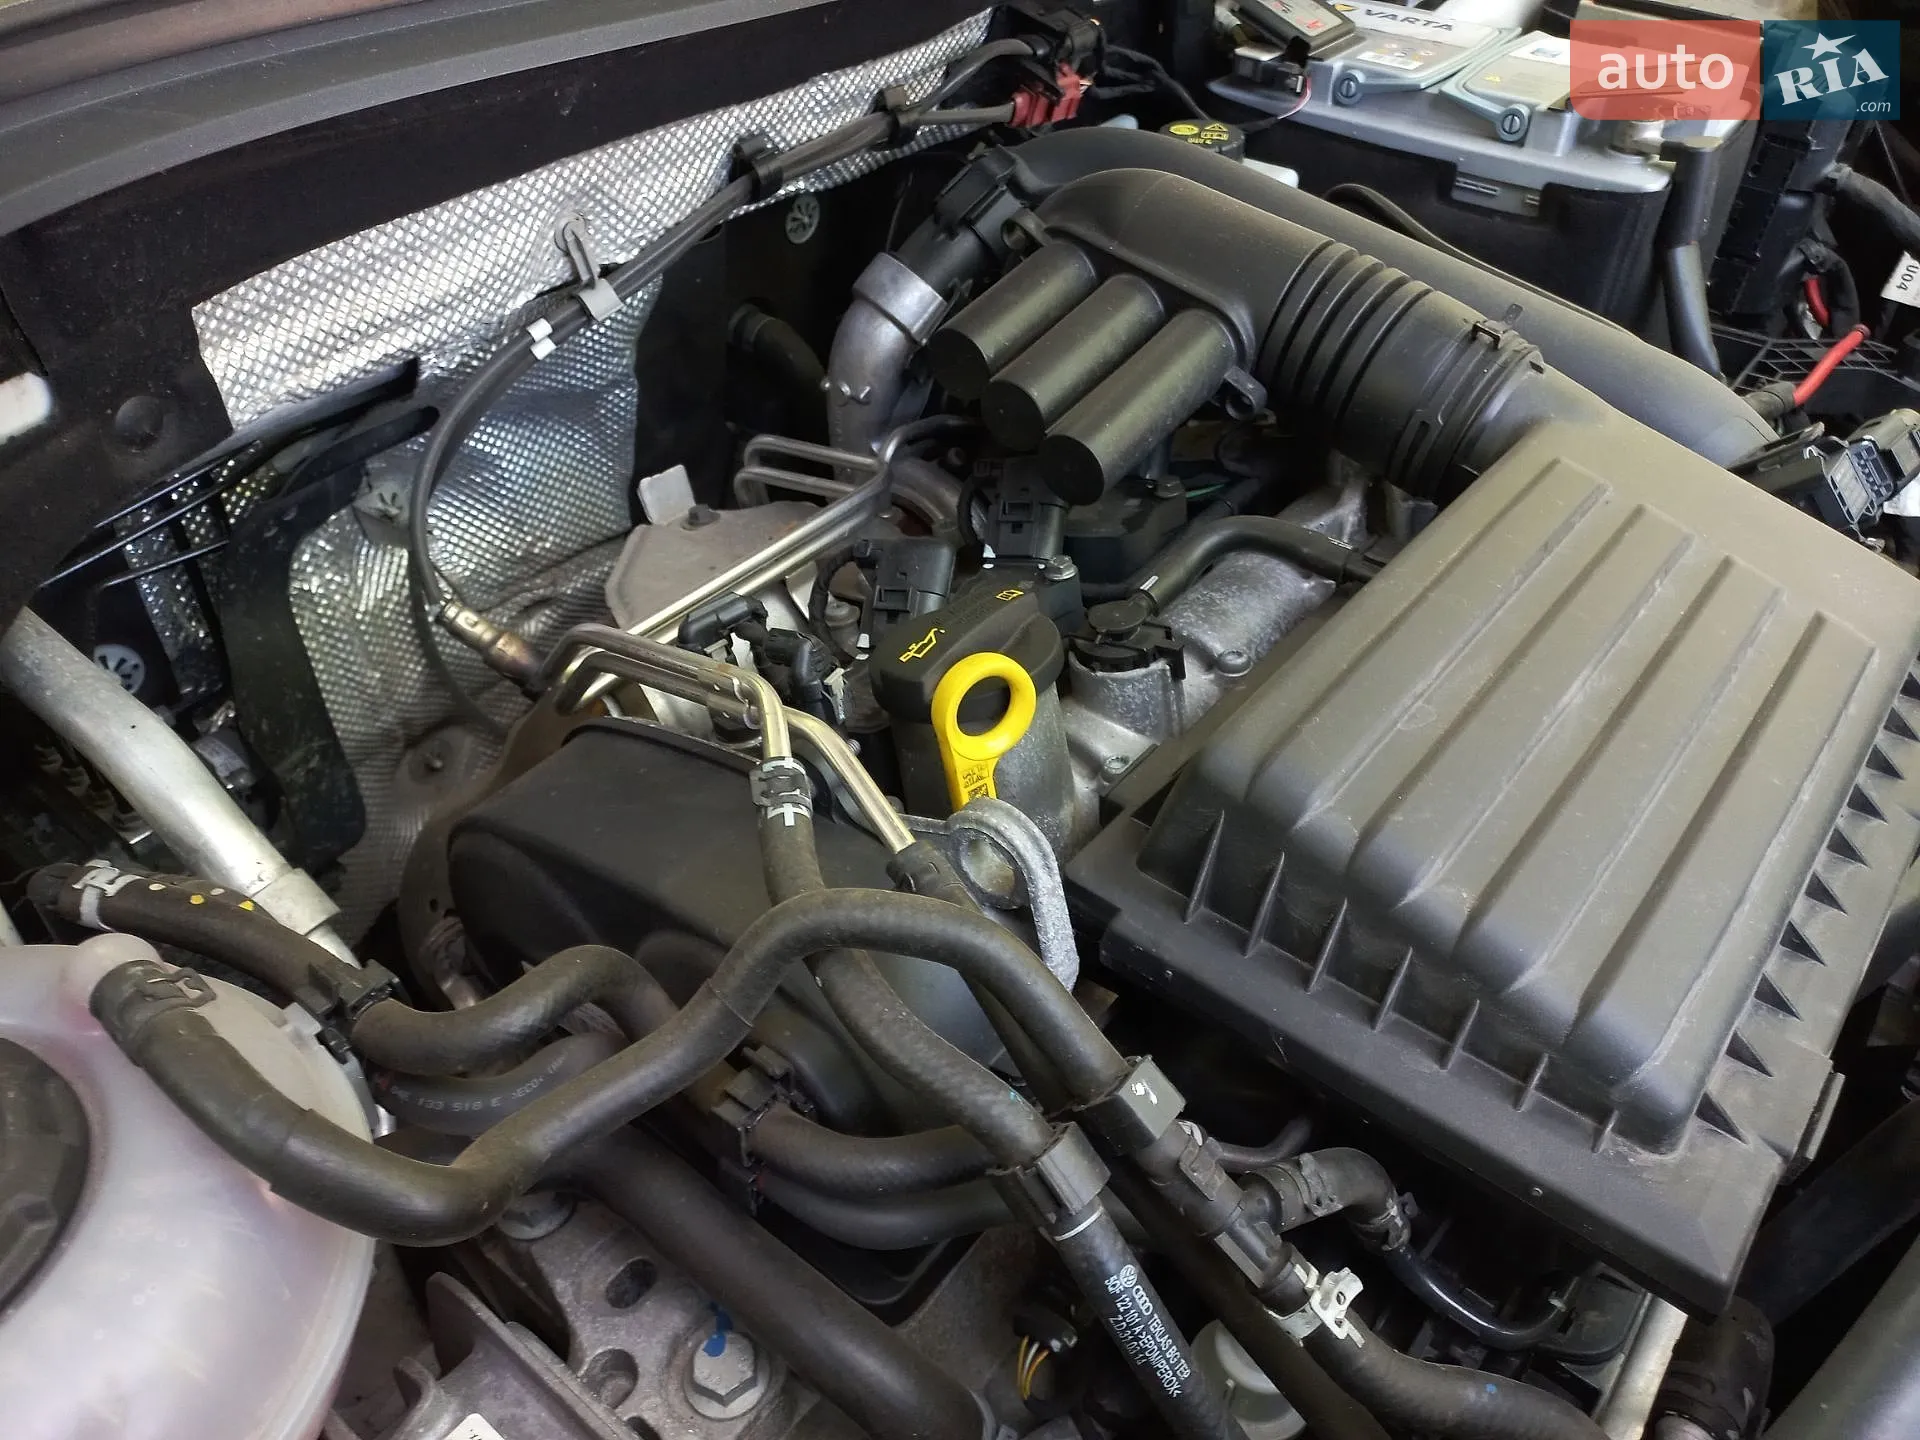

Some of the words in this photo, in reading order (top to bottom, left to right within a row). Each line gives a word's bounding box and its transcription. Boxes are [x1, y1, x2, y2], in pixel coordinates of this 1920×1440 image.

[1365, 8, 1453, 31] VARTA
[1104, 1274, 1124, 1295] 5QF
[1115, 1294, 1133, 1312] 122
[1123, 1309, 1142, 1327] 101
[1132, 1324, 1145, 1335] A
[1148, 1313, 1173, 1351] TEKLAS
[1165, 1346, 1181, 1364] BG
